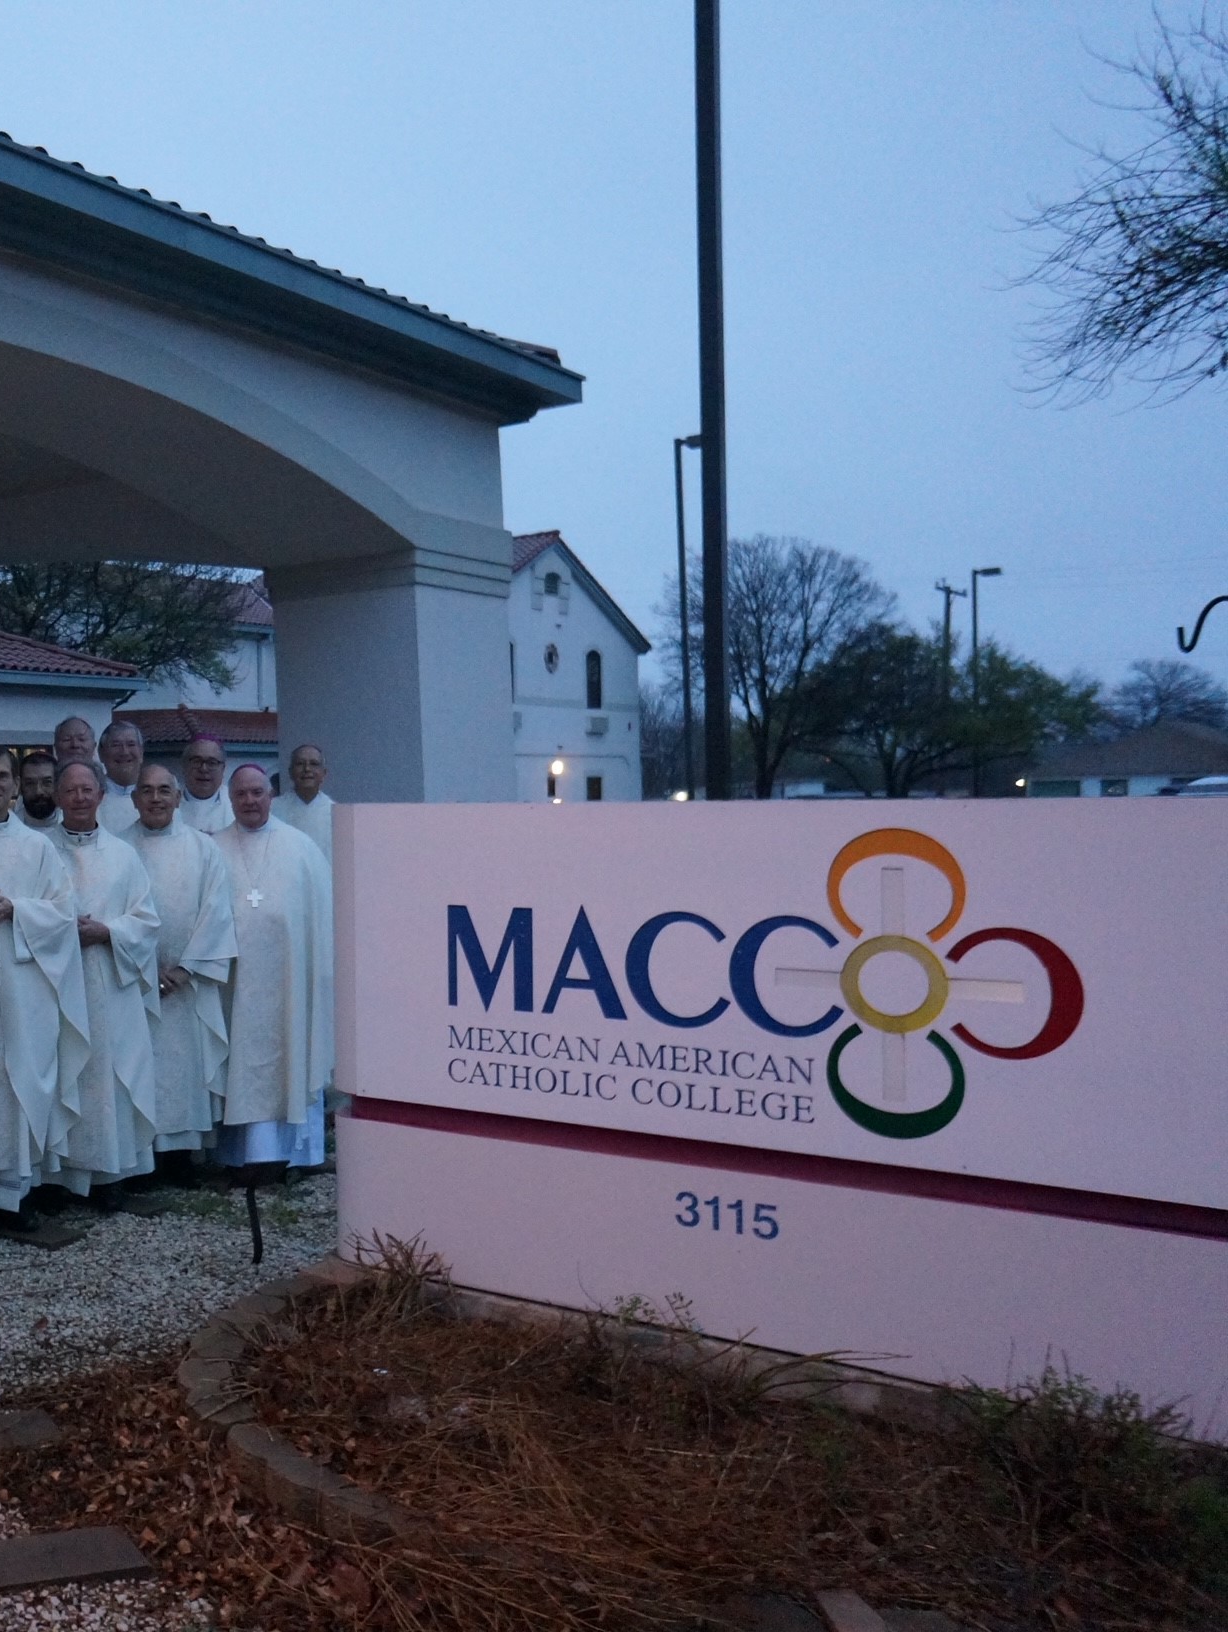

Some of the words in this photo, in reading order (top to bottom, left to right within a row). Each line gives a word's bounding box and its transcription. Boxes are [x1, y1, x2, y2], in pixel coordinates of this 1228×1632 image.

[447, 905, 845, 1037] MACC
[448, 1025, 601, 1063] MEXICAN
[609, 1041, 815, 1085] AMERICAN
[448, 1058, 617, 1101] CATHOLIC
[631, 1078, 815, 1124] COLLEGE
[675, 1191, 779, 1240] 3115
